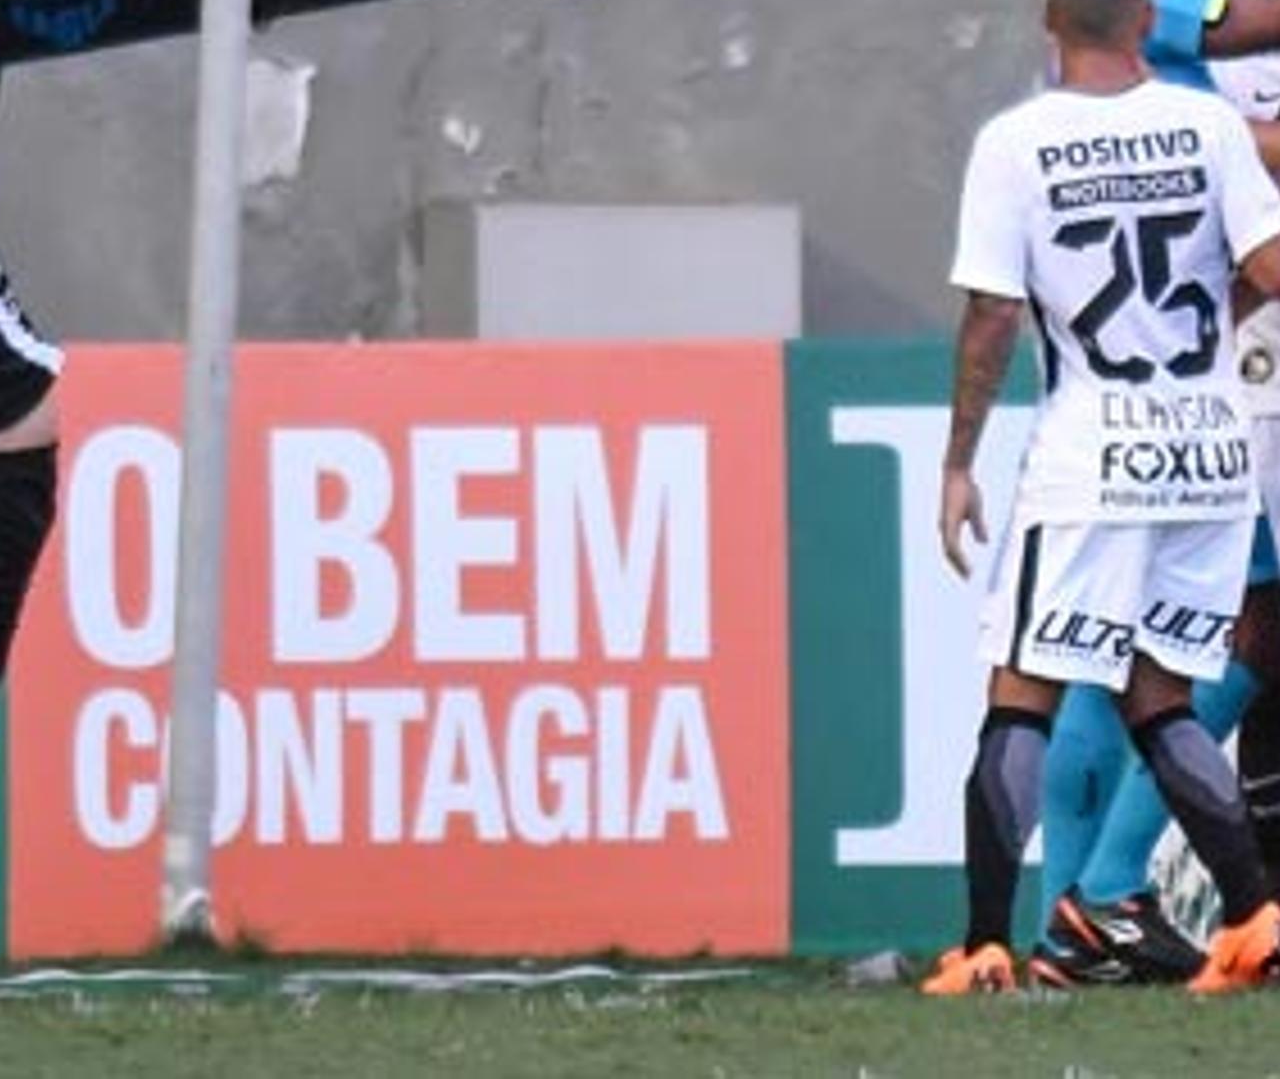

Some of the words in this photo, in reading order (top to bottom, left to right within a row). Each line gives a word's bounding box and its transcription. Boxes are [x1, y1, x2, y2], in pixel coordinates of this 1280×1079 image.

[1037, 128, 1201, 174] POSITIVO
[1051, 210, 1221, 384] 25
[269, 424, 712, 664] BEM
